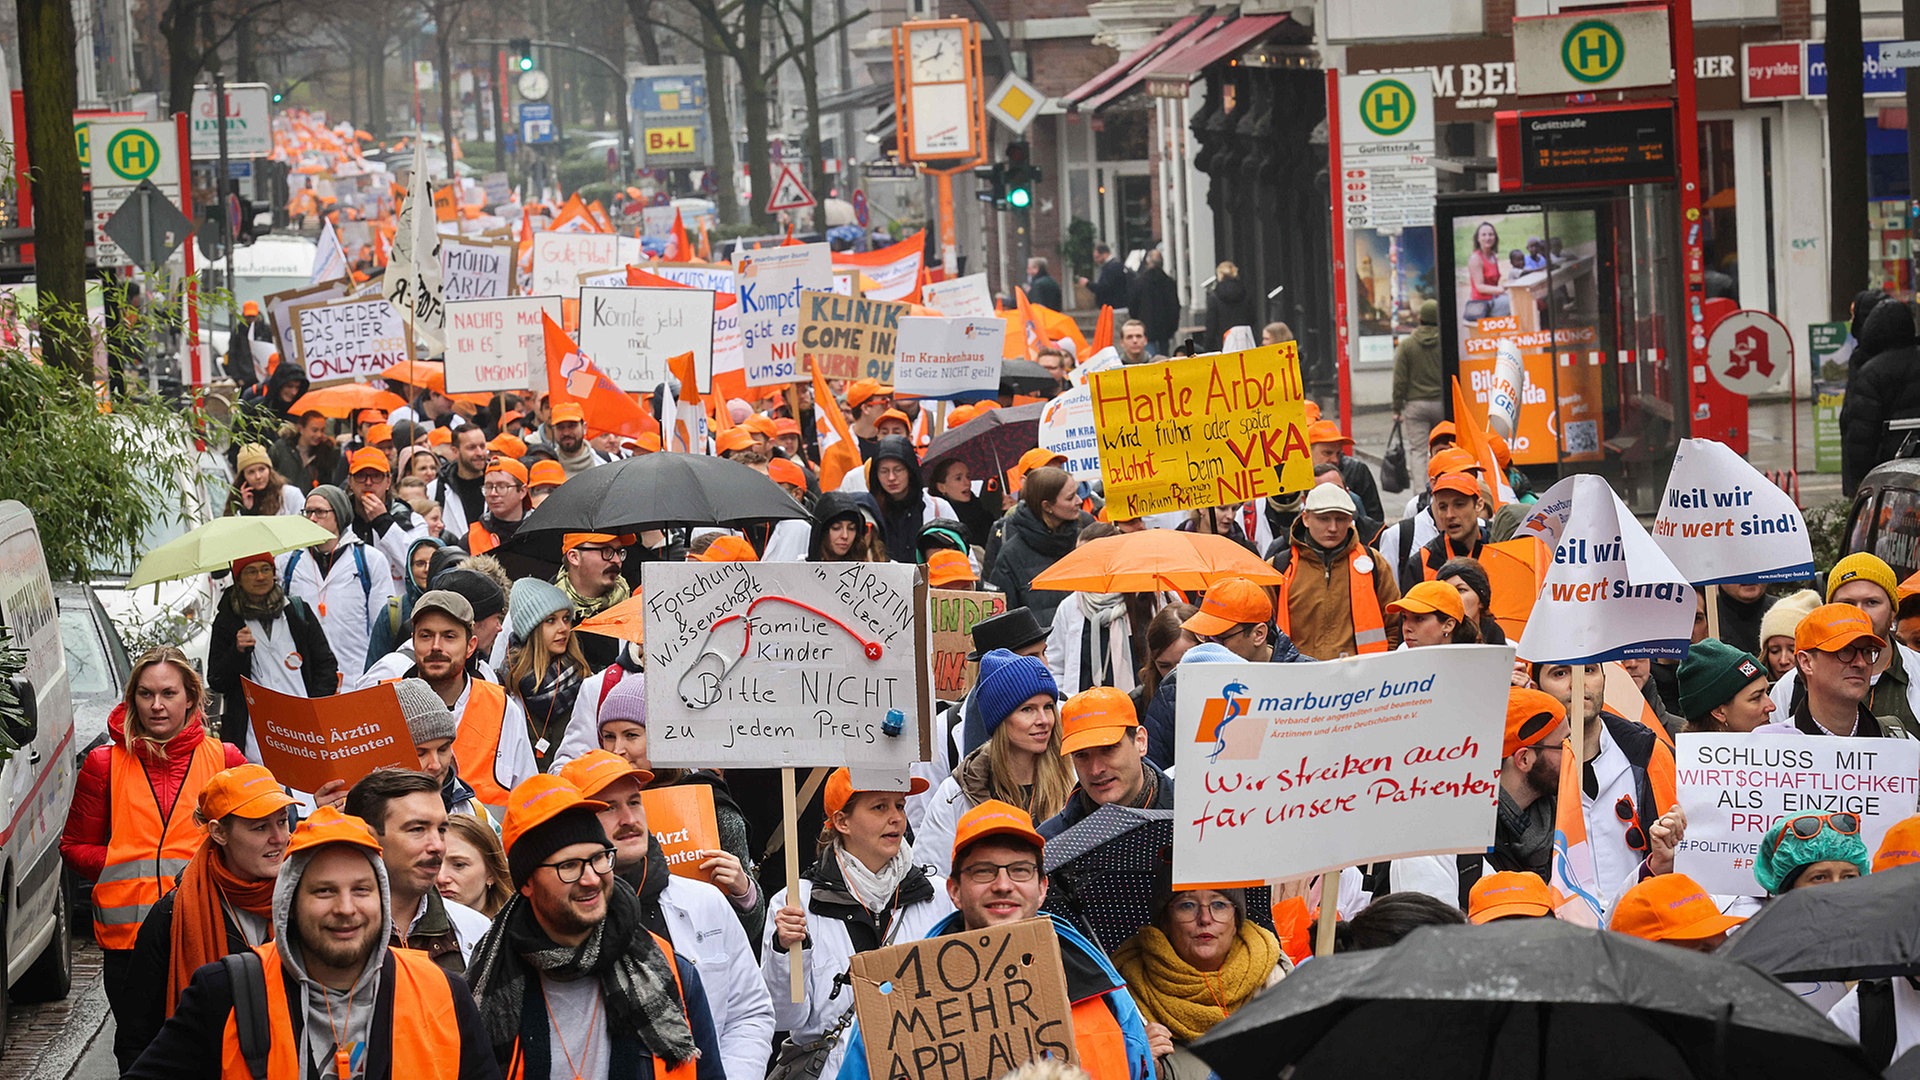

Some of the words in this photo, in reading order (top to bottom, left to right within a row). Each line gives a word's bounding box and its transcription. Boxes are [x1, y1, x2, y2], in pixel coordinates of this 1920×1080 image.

[1531, 118, 1587, 131] Gurlittstraße
[650, 132, 689, 149] B+L
[1359, 143, 1420, 153] Gurlittstraße
[740, 278, 833, 317] Kompet
[300, 302, 391, 326] ENTWEDER
[454, 312, 504, 329] NACHTS
[517, 312, 543, 325] MAC
[1482, 318, 1517, 331] 100%
[303, 325, 334, 343] DAS
[344, 321, 383, 338] HIER
[481, 336, 493, 352] ES
[745, 320, 774, 348] gibt
[782, 323, 796, 336] es
[802, 325, 863, 350] COME
[305, 340, 365, 358] KLAPPT
[371, 337, 405, 352] ODER
[901, 353, 916, 363] Im
[919, 352, 985, 364] Krankenhaus
[867, 359, 894, 380] OU
[900, 368, 912, 378] ist
[915, 368, 938, 378] Geiz
[941, 366, 969, 378] NICHT
[971, 366, 994, 379] geil!
[1095, 370, 1193, 428] Harte
[1204, 345, 1302, 416] Arbeit
[1065, 428, 1076, 438] IM
[1078, 425, 1096, 436] KRA
[1155, 420, 1193, 446] früher
[1203, 420, 1230, 441] oder
[1239, 410, 1272, 439] später
[1081, 456, 1100, 471] WE
[1106, 453, 1158, 484] belohnt
[1186, 451, 1225, 482] beim
[1226, 422, 1310, 469] VKA
[1127, 492, 1172, 516] Klinikum
[1668, 488, 1708, 508] Weil
[1713, 486, 1753, 506] wir
[1682, 519, 1735, 538] wert
[1740, 513, 1797, 535] sind!
[1554, 538, 1587, 564] eil
[814, 565, 827, 581] in
[648, 562, 751, 622] Forschung
[839, 562, 914, 631] ÄRZTIN
[1552, 577, 1608, 602] wert
[652, 576, 762, 667] Wissenschaft
[674, 611, 687, 633] &
[745, 616, 829, 636] Familie
[835, 579, 898, 649] Teilzeit
[757, 642, 833, 662] Kinder
[696, 672, 777, 705] Bitte
[801, 671, 898, 708] NICHT
[1258, 687, 1375, 711] marburger
[1378, 674, 1436, 699] bund
[1274, 717, 1309, 726] Verband
[1311, 714, 1325, 723] der
[1326, 707, 1373, 722] angestellten
[1374, 703, 1388, 713] und
[1390, 698, 1433, 709] beamteten
[267, 720, 325, 745] Gesunde
[330, 722, 381, 744] Ärztin
[665, 723, 695, 740] zu
[723, 718, 795, 749] jedem
[813, 709, 875, 744] Preis
[1270, 729, 1312, 739] Ärztinnen
[1314, 727, 1330, 735] und
[1331, 723, 1352, 734] Ärzte
[1354, 714, 1402, 730] Deutschlands
[265, 735, 317, 760] Gesunde
[320, 735, 395, 761] Patienten
[1698, 746, 1813, 769] SCHLUSS
[1836, 751, 1878, 770] MIT
[1205, 769, 1271, 795] Wir
[1404, 735, 1479, 765] auch
[1679, 769, 1918, 794] WIRT$CHAFTLICHK€IT
[1265, 792, 1357, 826] unsere
[1717, 790, 1763, 809] ALS
[1784, 793, 1880, 816] EINZIGE
[656, 827, 689, 845] Arzt
[1679, 840, 1759, 854] #POLITIKVE
[664, 848, 704, 867] enten
[1734, 859, 1754, 870] #P
[895, 933, 1018, 999] 10%
[888, 979, 1039, 1050] MEHR
[888, 1019, 1070, 1080] APPLAUS
